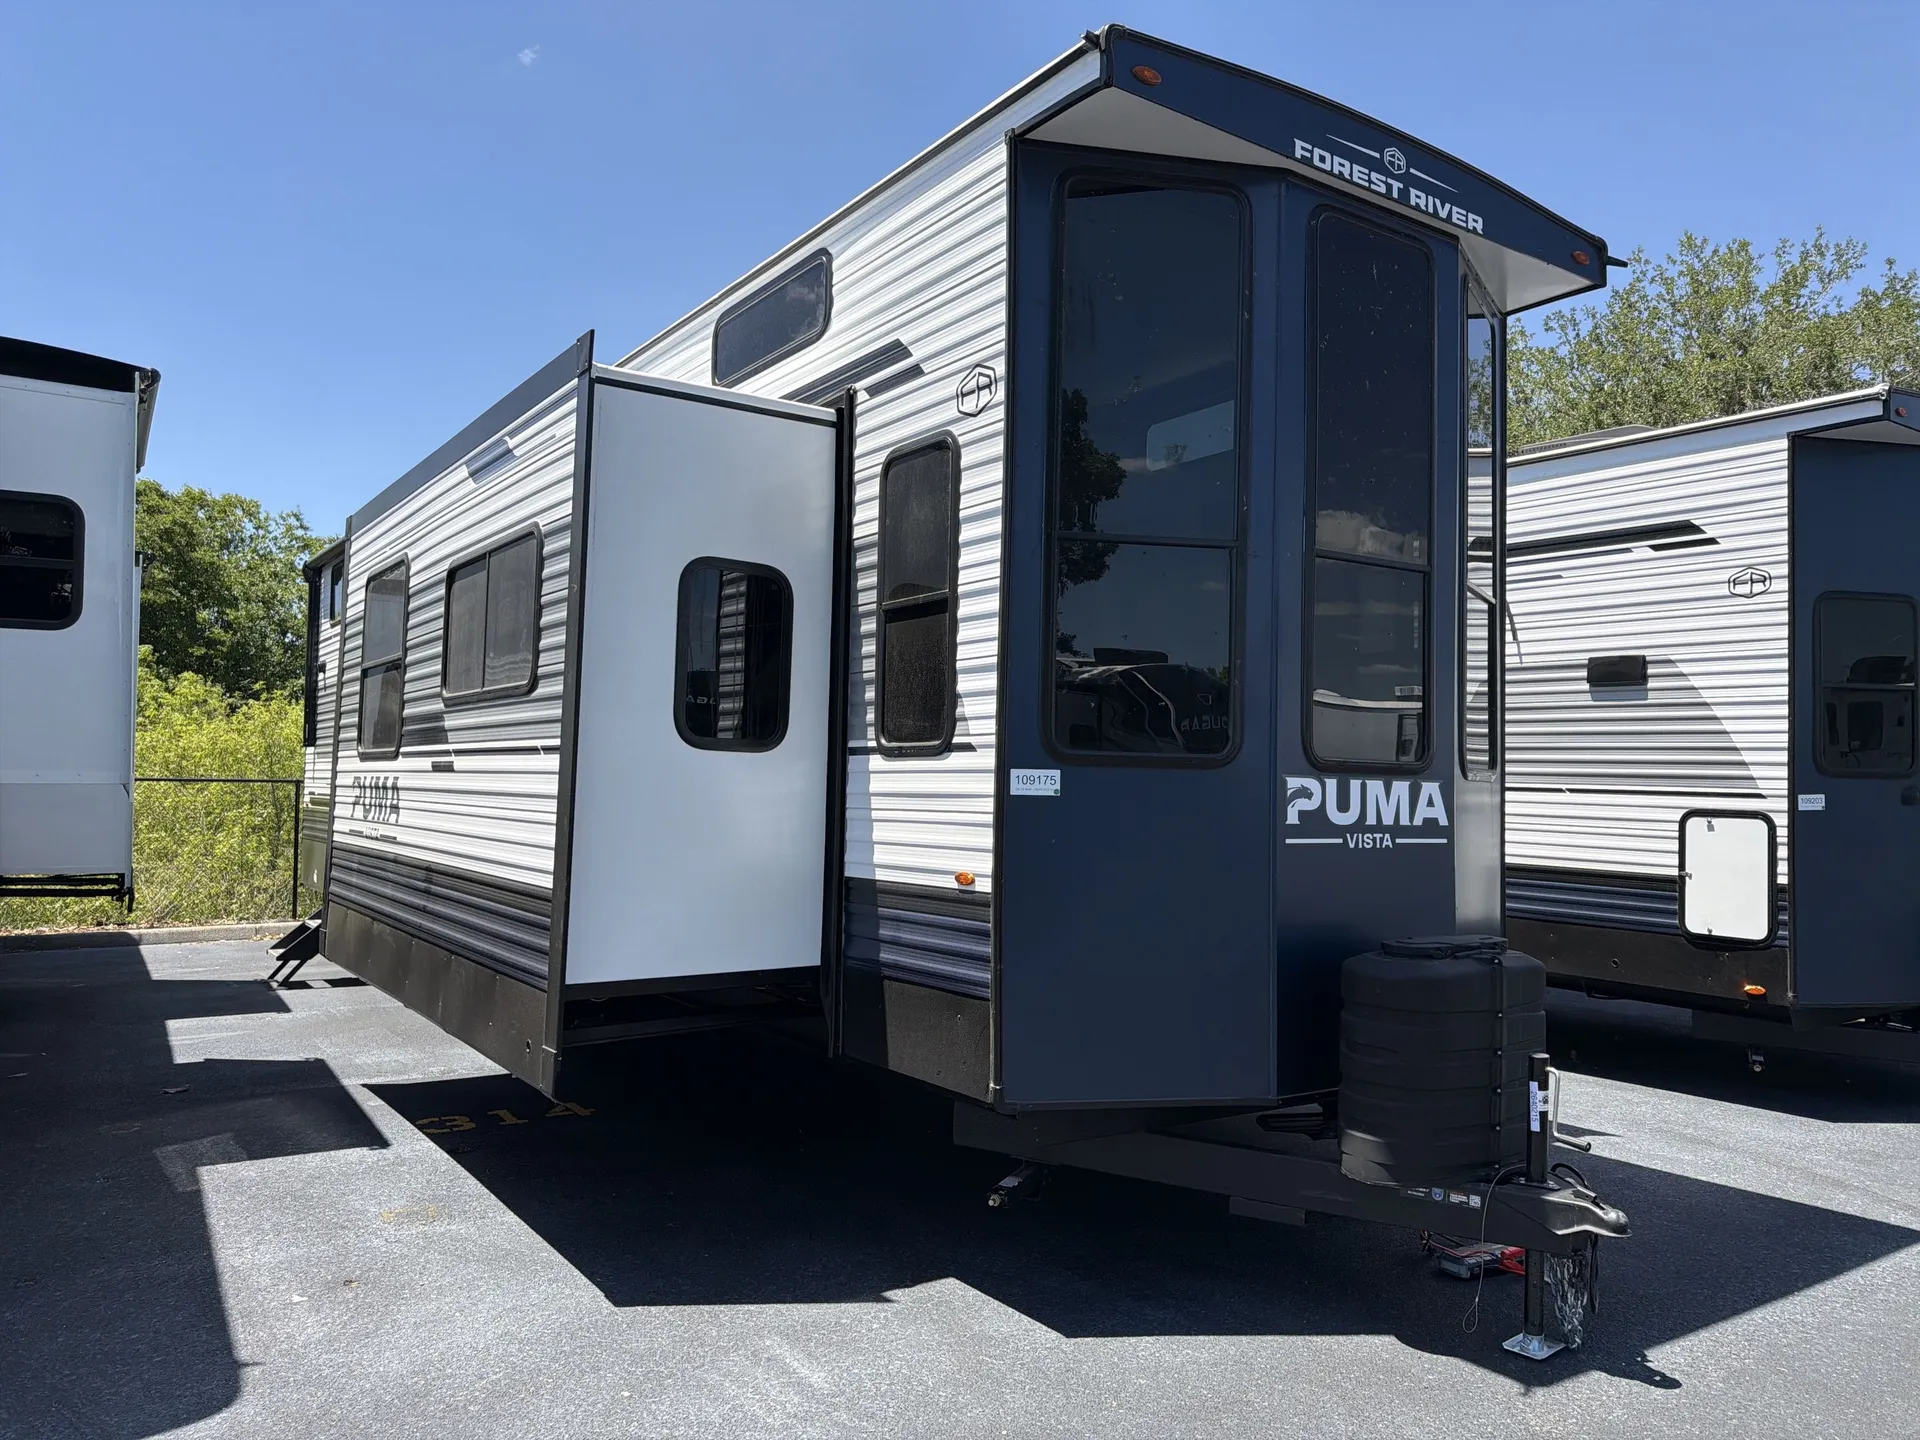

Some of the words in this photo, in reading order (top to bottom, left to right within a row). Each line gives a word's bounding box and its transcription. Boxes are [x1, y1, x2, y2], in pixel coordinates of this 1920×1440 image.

[1293, 137, 1403, 199] FOREST
[1408, 186, 1484, 234] RIVER
[1015, 774, 1057, 786] 109175
[350, 776, 400, 824] PUMA
[1285, 776, 1449, 826] PUMA
[1800, 797, 1824, 805] 109203
[1346, 833, 1393, 848] VISTA
